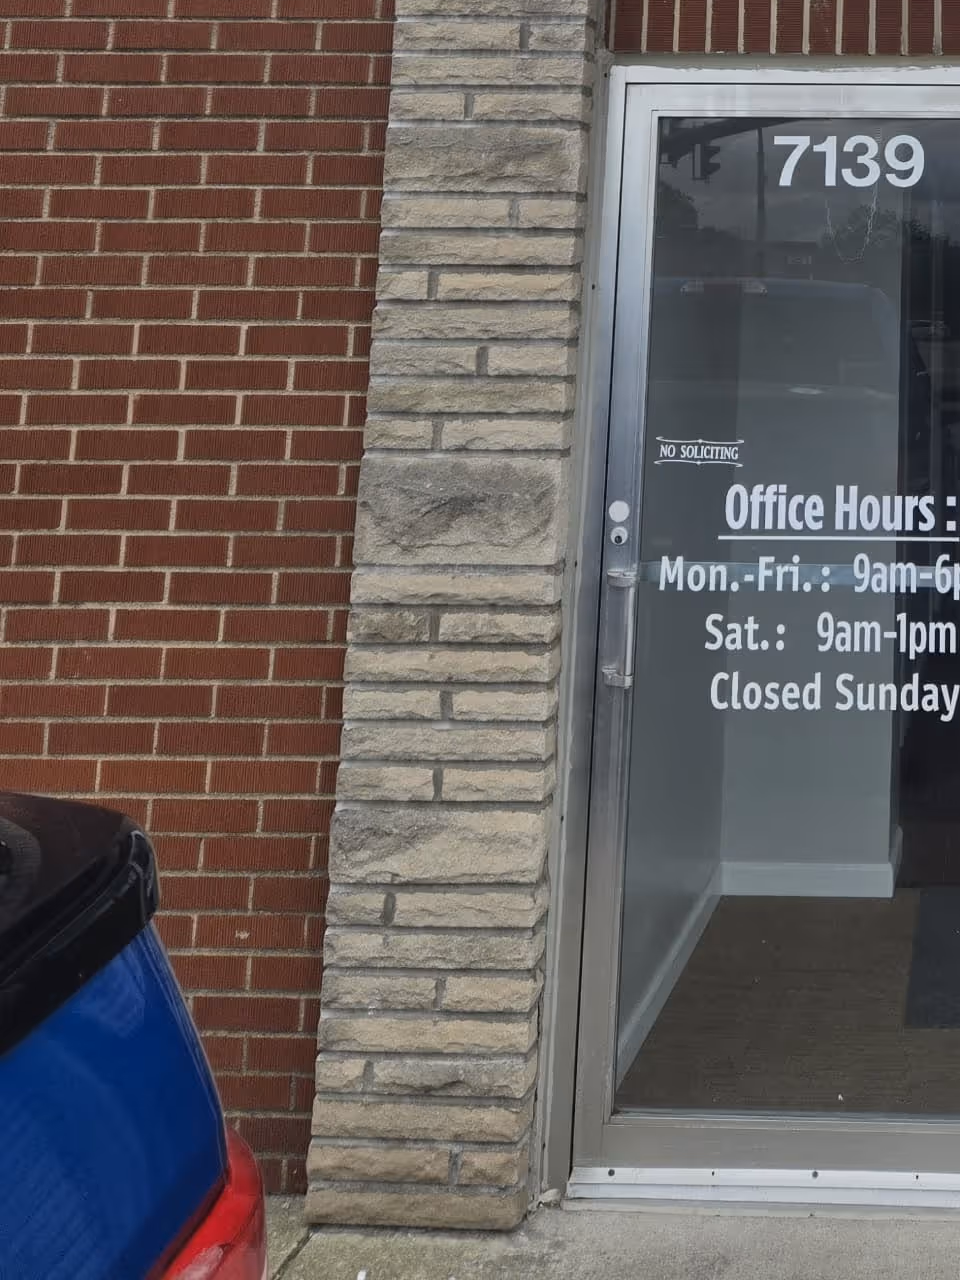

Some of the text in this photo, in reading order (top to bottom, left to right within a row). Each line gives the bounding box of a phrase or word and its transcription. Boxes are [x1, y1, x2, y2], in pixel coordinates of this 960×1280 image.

[773, 134, 926, 188] 7139
[659, 444, 739, 461] NO SOLICITING
[725, 483, 825, 532] Office
[817, 611, 957, 660] 9am-1pm
[710, 671, 960, 723] Closed Sunday
